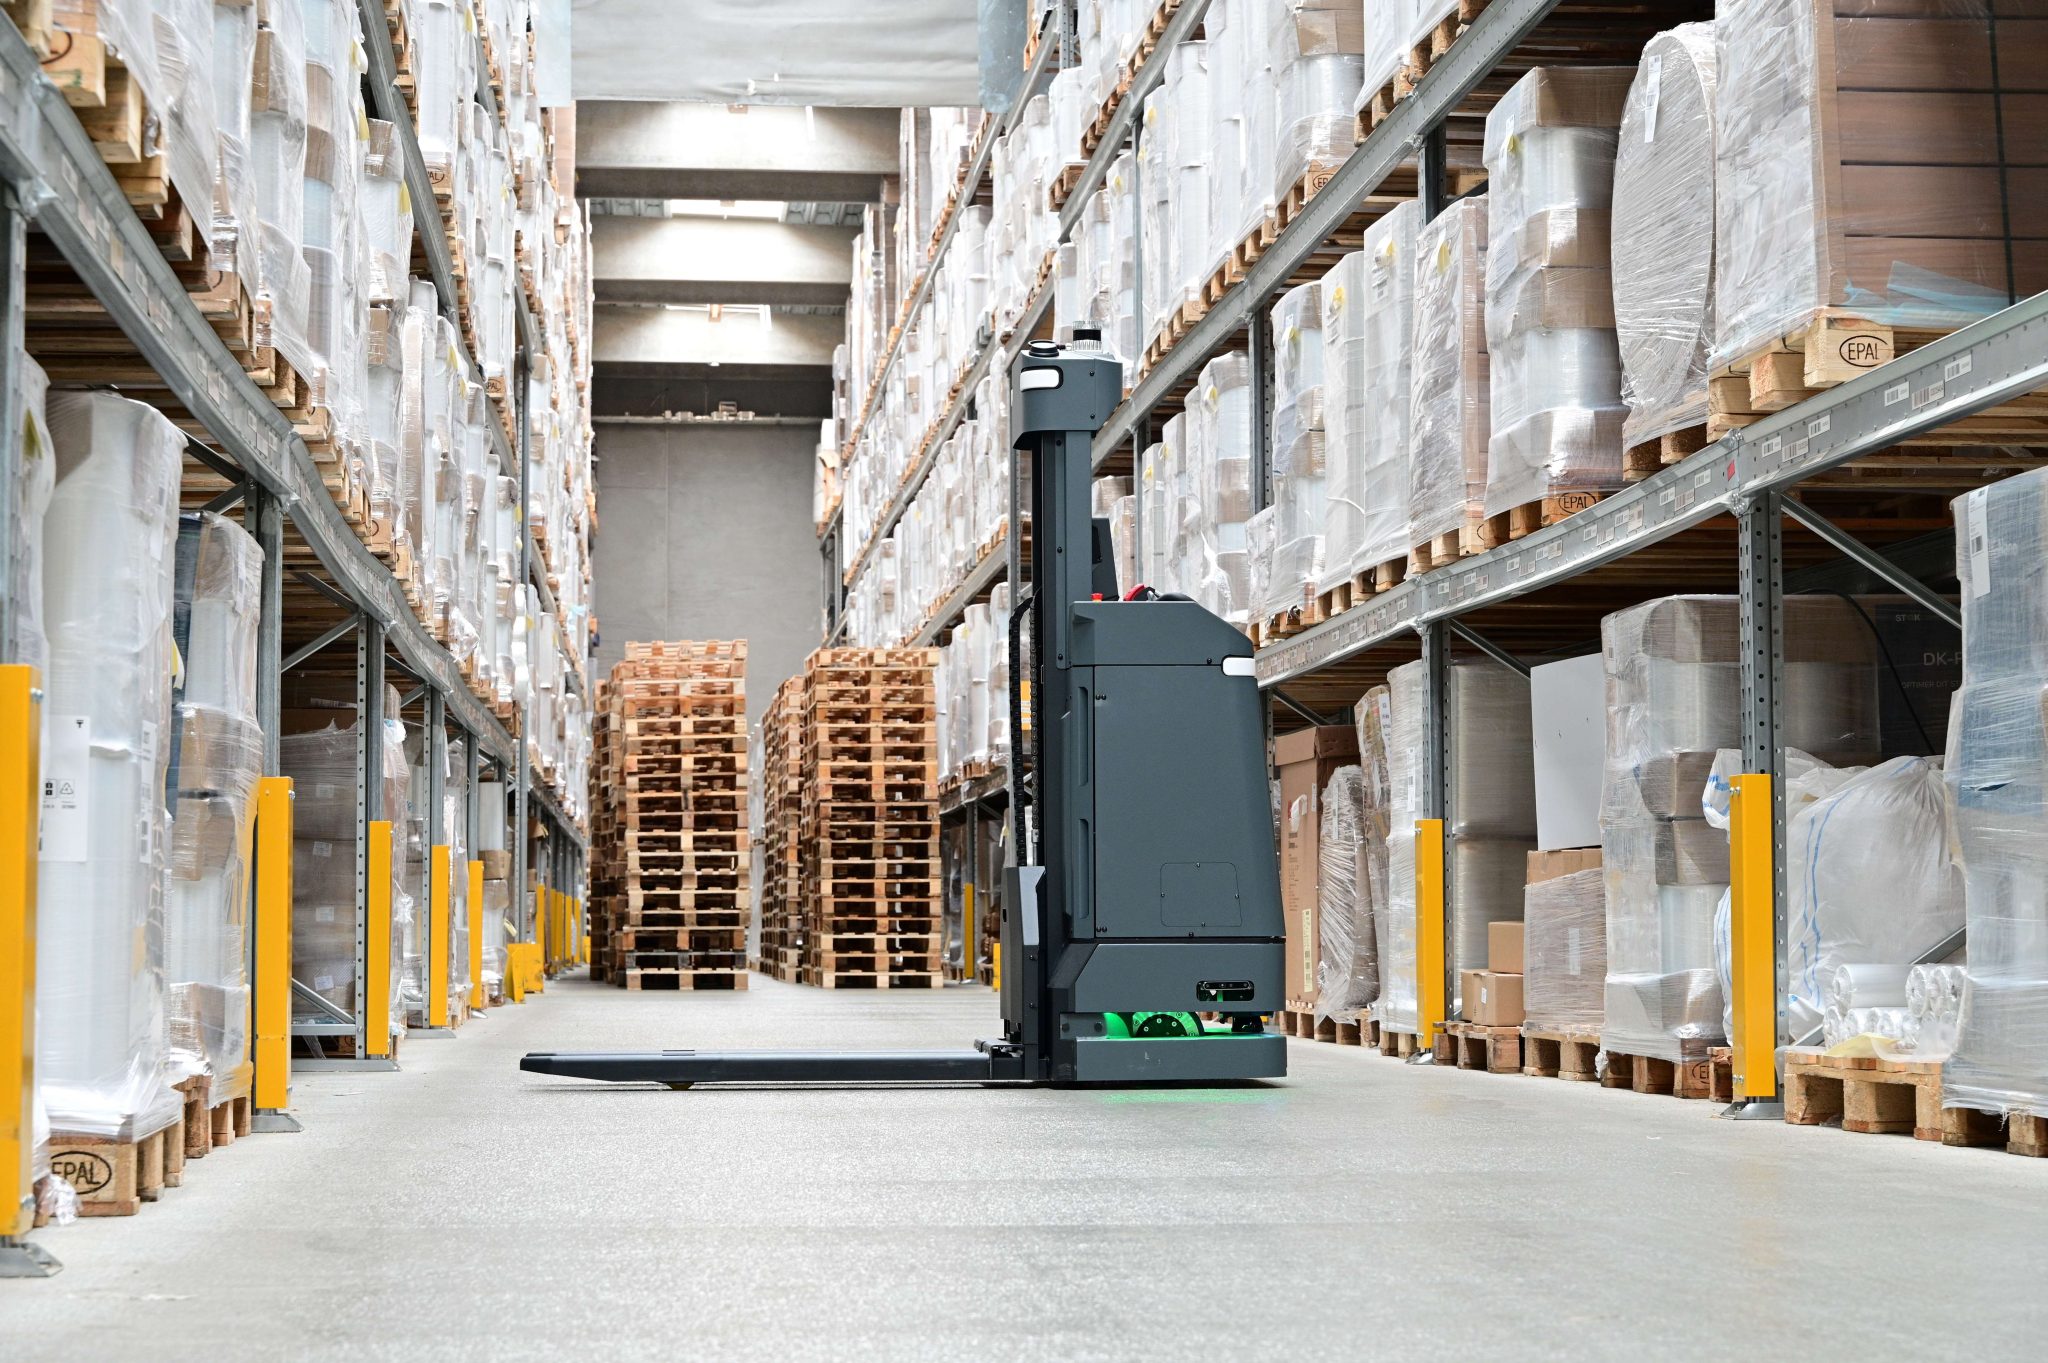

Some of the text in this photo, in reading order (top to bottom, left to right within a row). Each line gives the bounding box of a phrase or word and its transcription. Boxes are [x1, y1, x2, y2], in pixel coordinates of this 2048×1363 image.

[1848, 342, 1880, 360] EPAL
[1563, 495, 1588, 509] EPAL
[51, 1161, 101, 1185] EPAL
